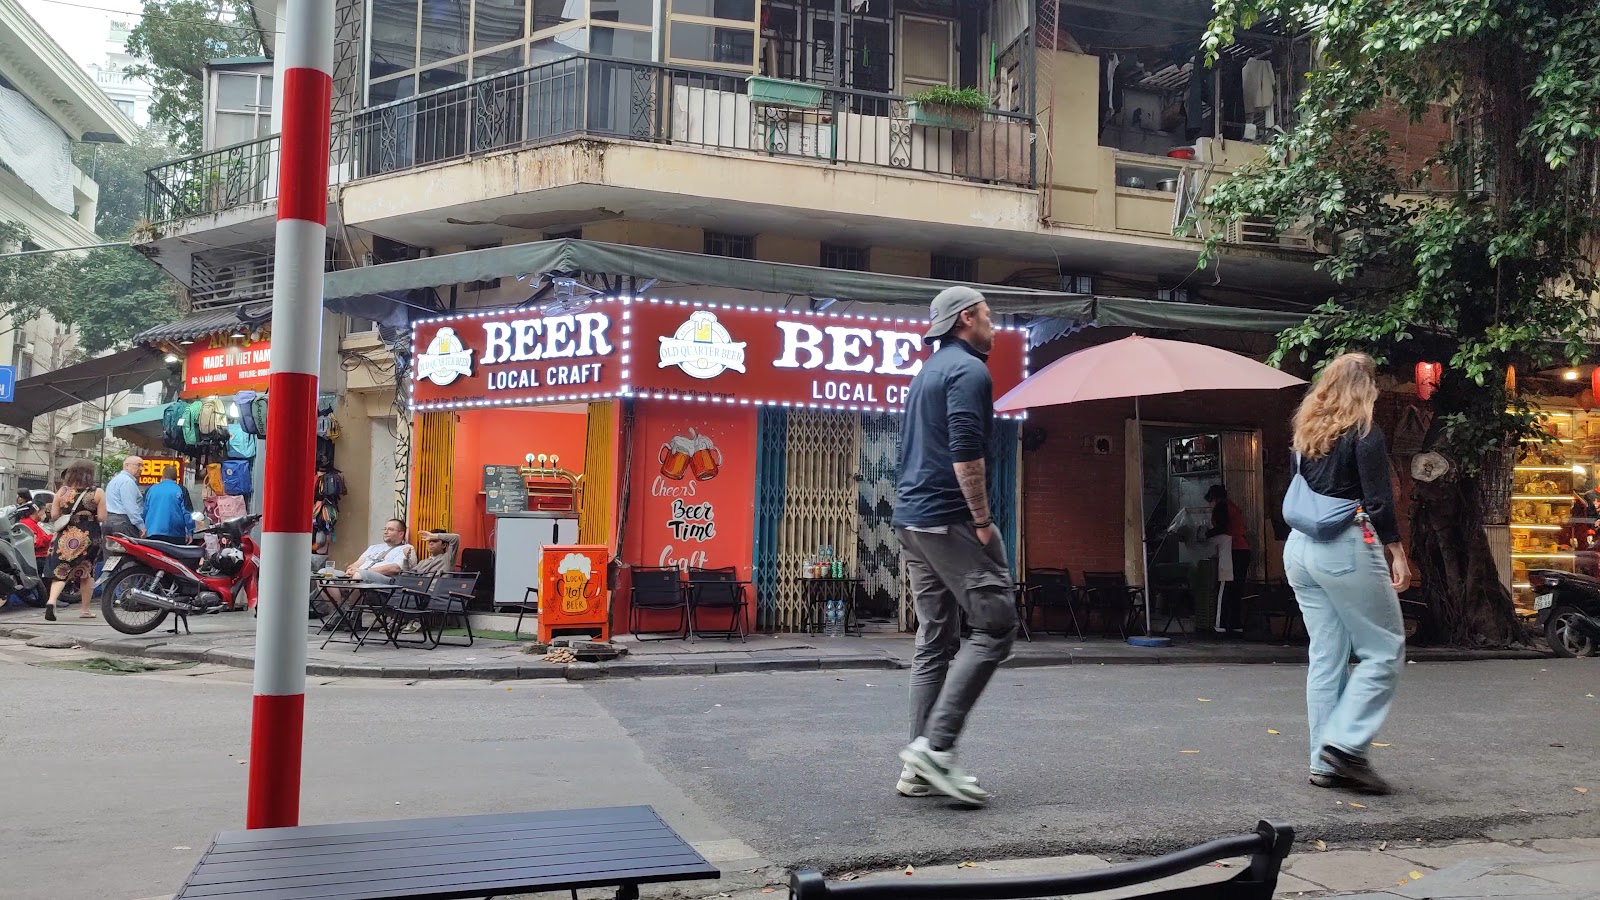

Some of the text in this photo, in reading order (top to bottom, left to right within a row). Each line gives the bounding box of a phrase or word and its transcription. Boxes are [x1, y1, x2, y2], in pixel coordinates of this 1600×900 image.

[480, 312, 613, 365] BEER
[772, 321, 941, 376] BEE
[203, 348, 270, 369] MADE IN VIET NAM
[661, 345, 743, 361] OLD QUARTER BEER
[487, 363, 602, 390] LOCAL CRAFT
[812, 380, 878, 402] LOCAL
[672, 498, 714, 520] Beer
[667, 520, 716, 542] Time
[566, 601, 584, 610] BEER
